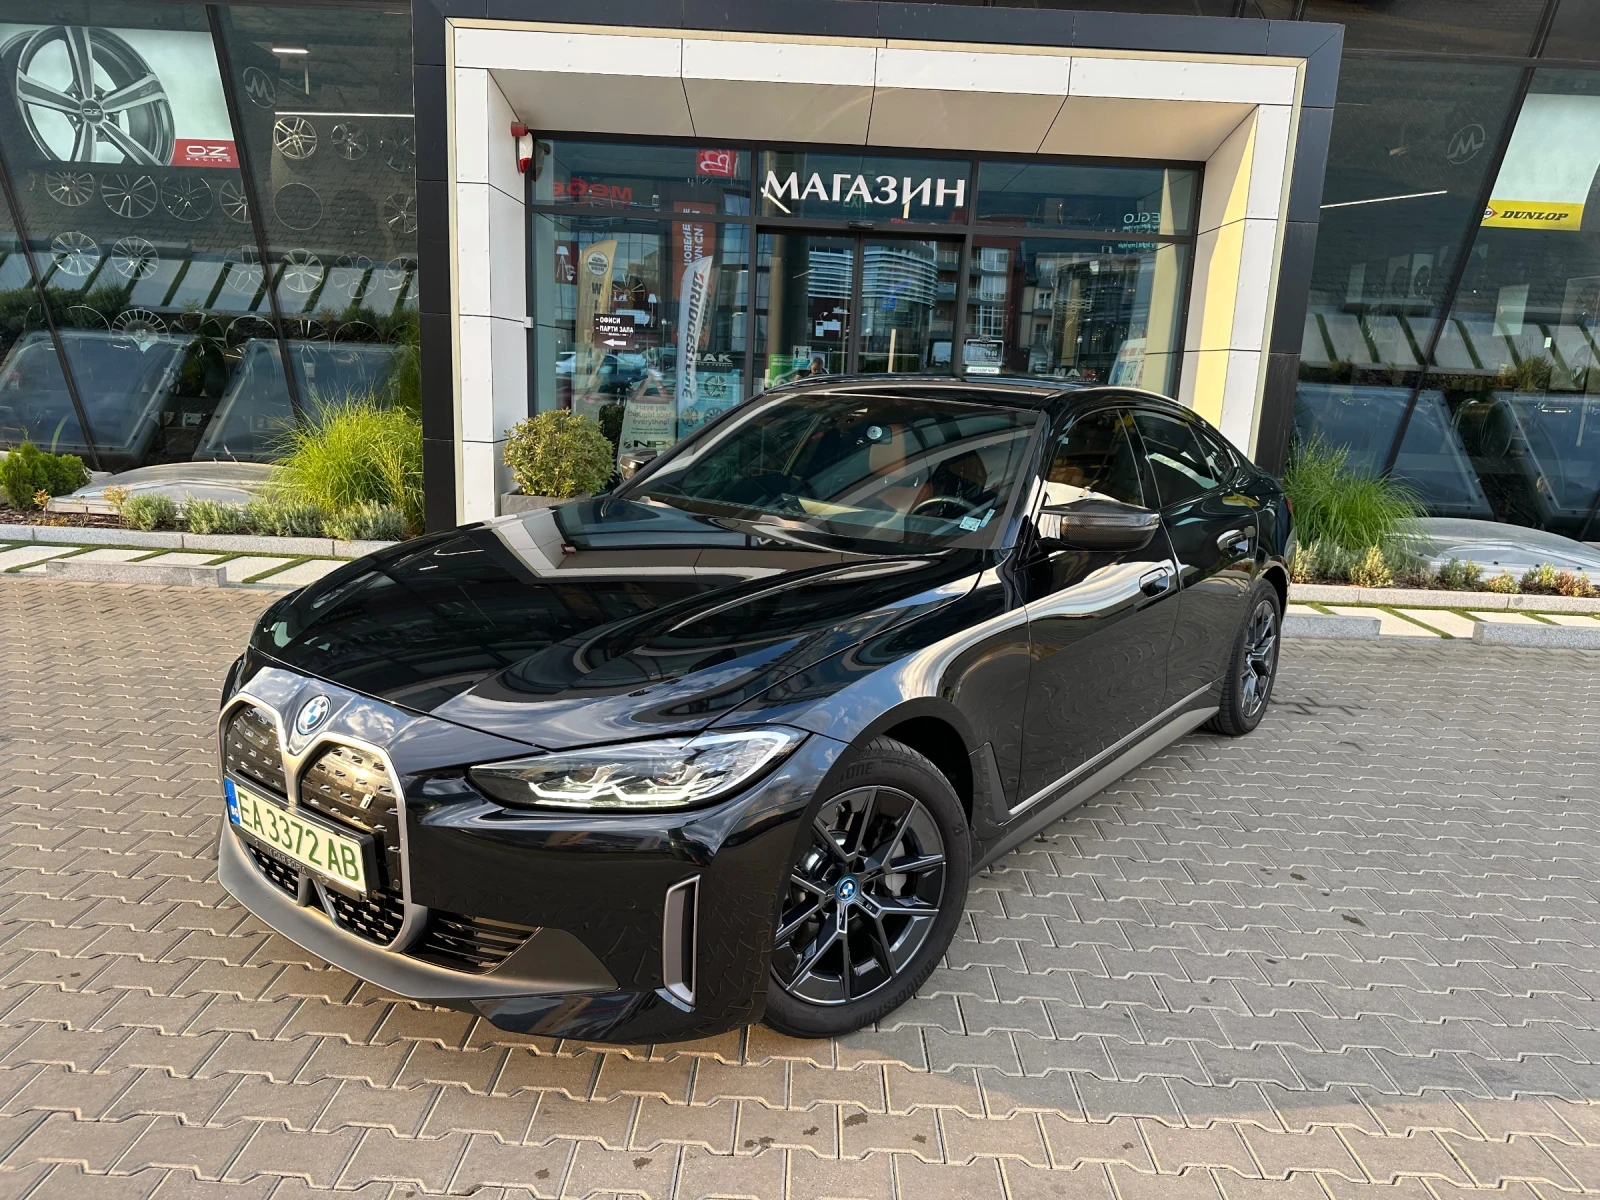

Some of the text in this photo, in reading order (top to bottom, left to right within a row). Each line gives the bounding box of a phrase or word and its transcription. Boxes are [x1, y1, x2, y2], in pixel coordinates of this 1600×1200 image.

[762, 170, 966, 207] МАГАЗИН
[1500, 210, 1569, 221] DUNLOP
[237, 790, 360, 882] EA 3372 AB
